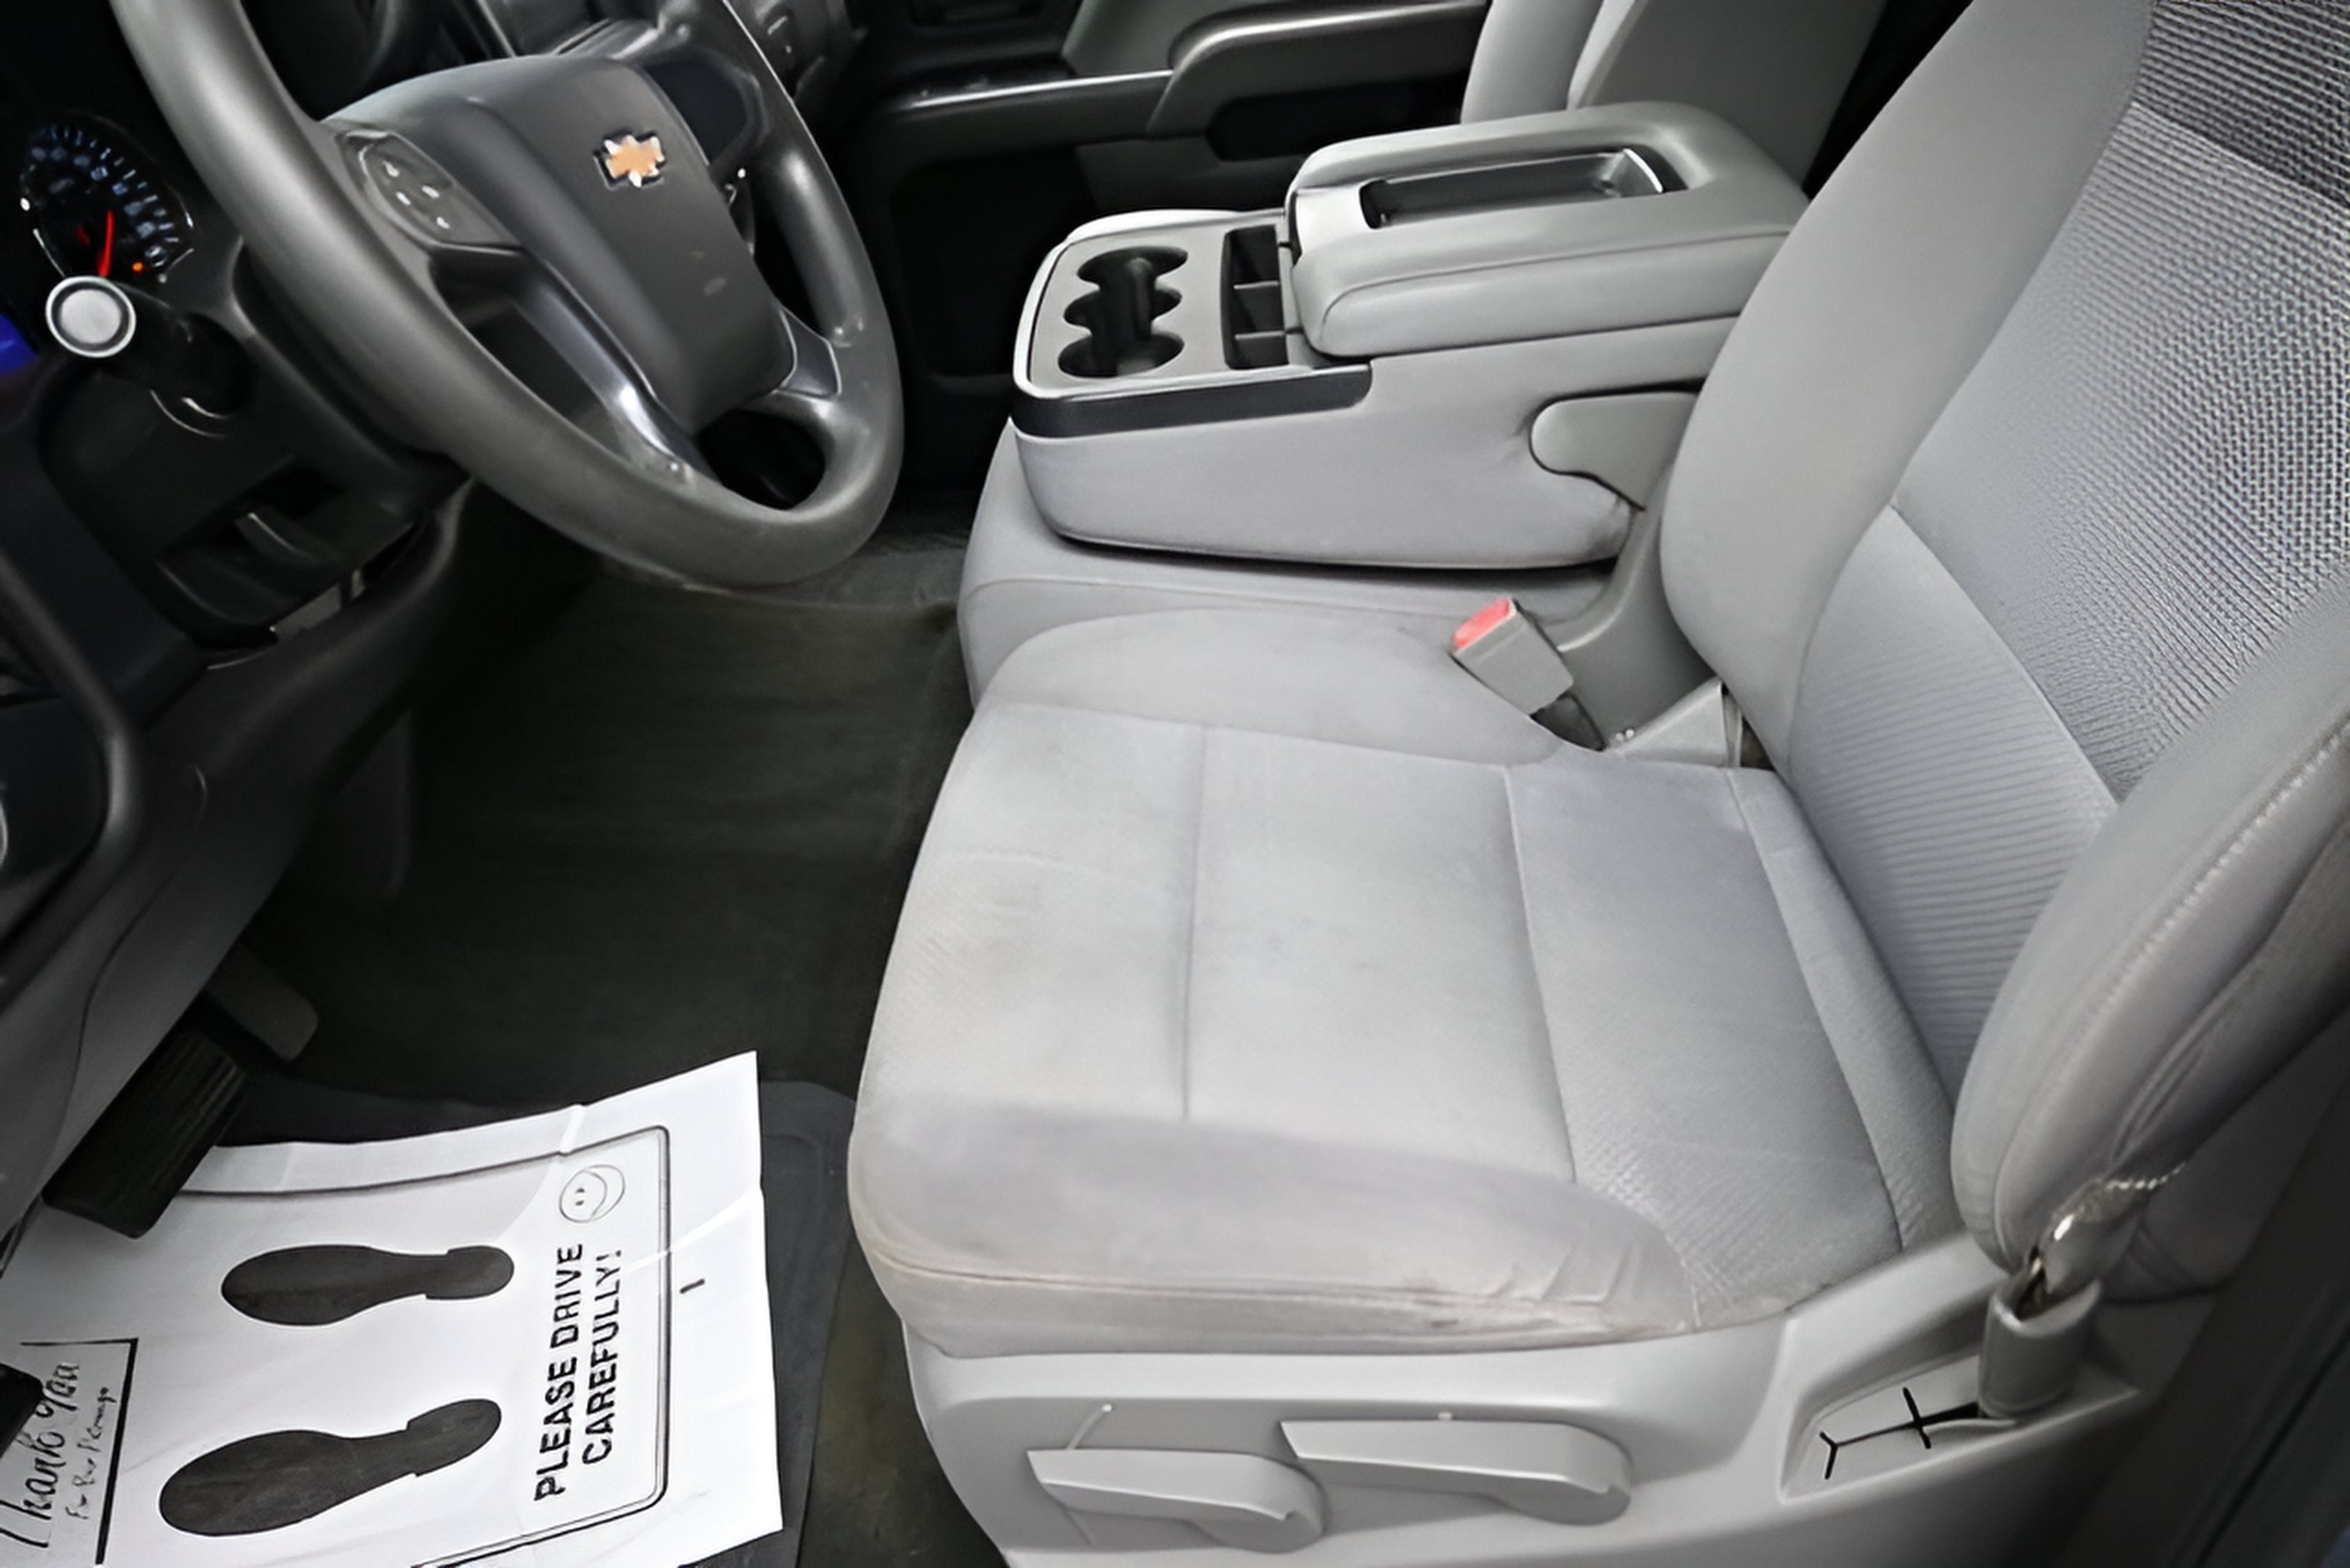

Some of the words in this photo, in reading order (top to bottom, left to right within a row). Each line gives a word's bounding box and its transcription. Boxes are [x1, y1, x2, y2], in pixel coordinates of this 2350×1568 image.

[550, 1244, 583, 1349] DRIVE
[582, 1249, 622, 1465] CAREFULLY!
[534, 1356, 577, 1501] PLEASE
